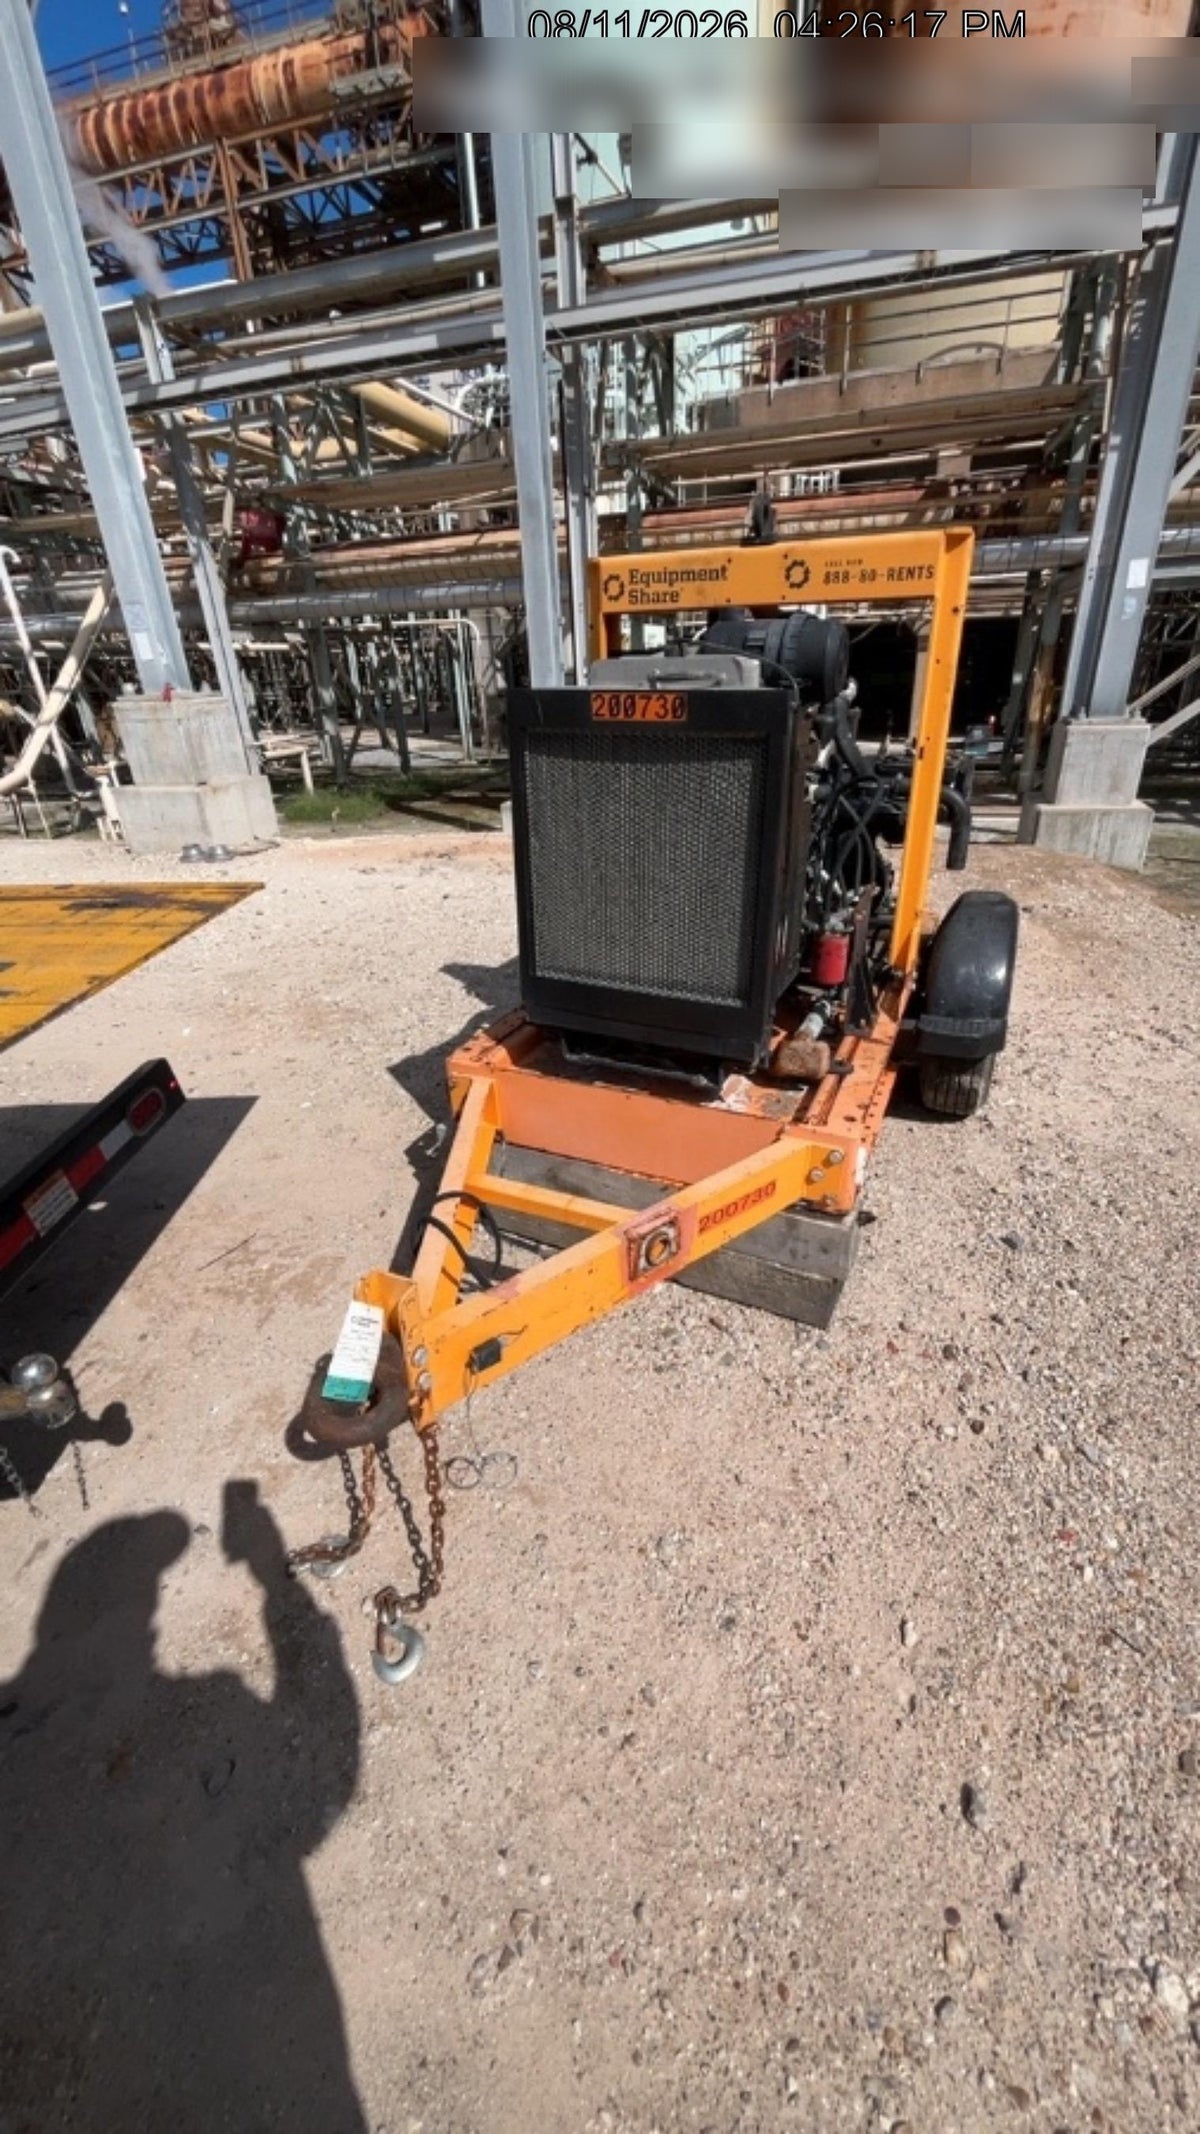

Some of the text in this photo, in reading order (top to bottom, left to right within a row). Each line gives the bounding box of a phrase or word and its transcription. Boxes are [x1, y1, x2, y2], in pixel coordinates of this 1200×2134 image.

[628, 564, 728, 588] Equipment
[628, 588, 680, 605] Share
[592, 693, 686, 719] 200730
[698, 1179, 777, 1235] 200730
